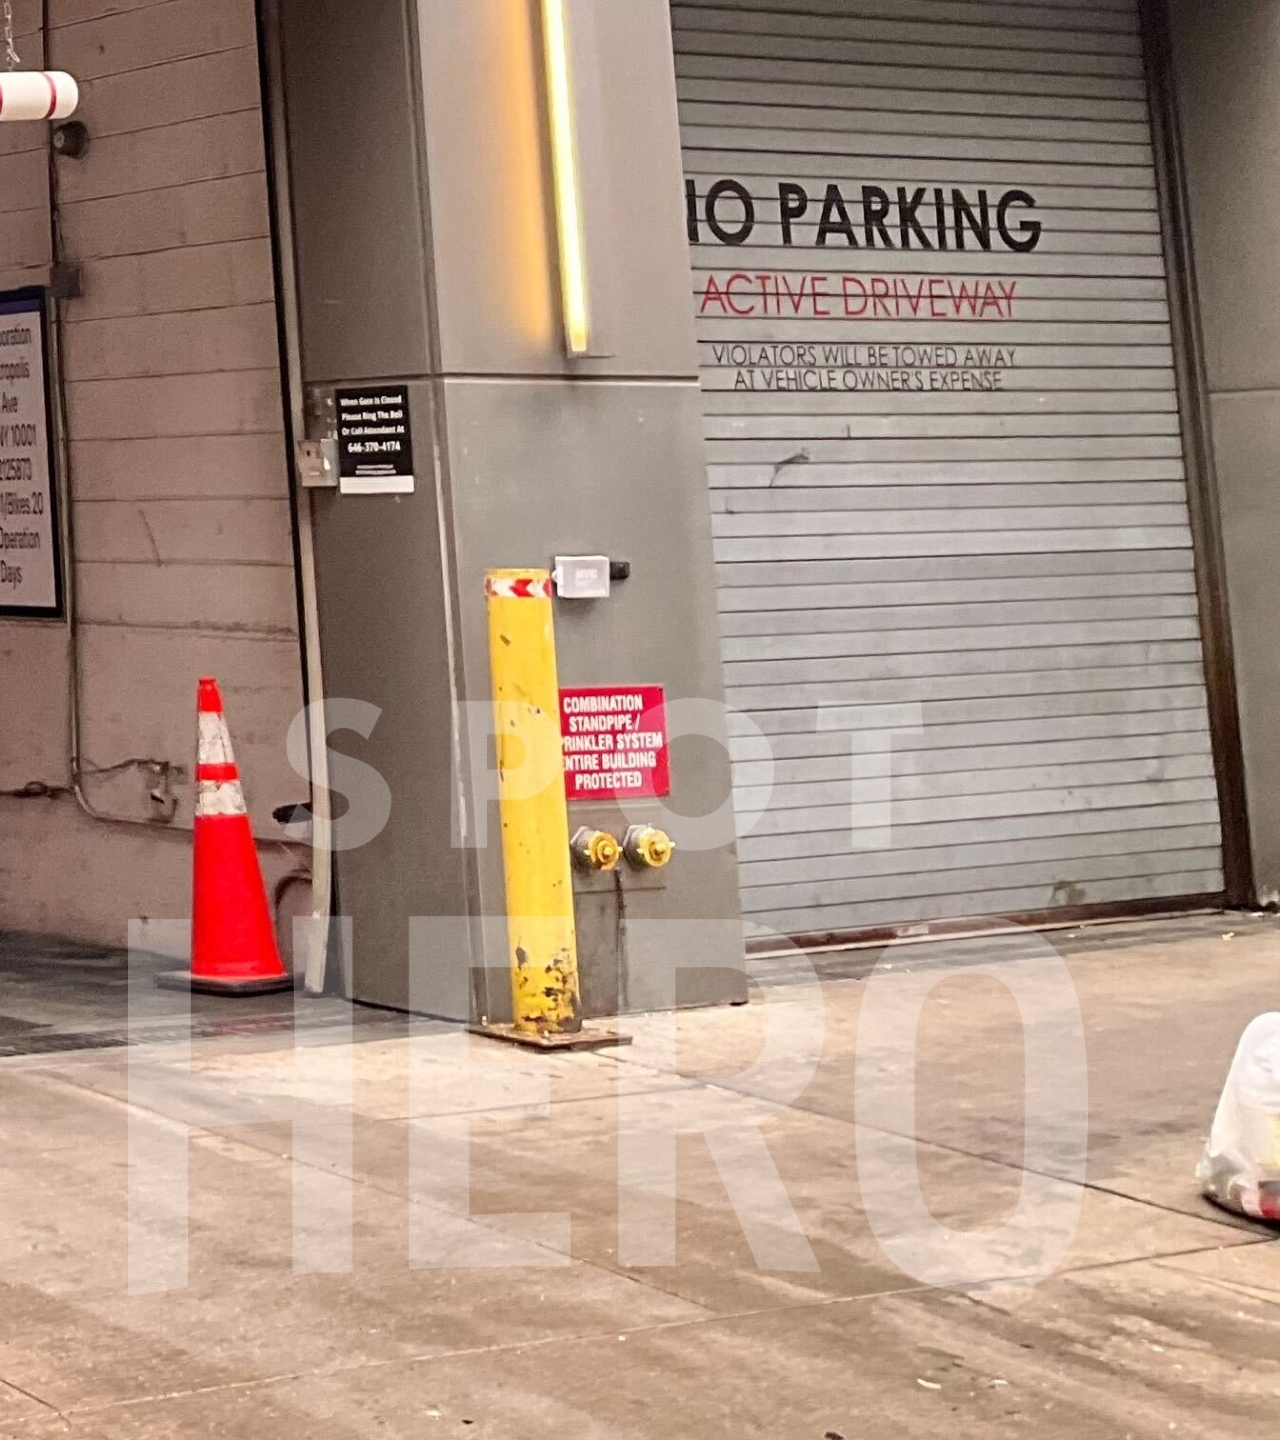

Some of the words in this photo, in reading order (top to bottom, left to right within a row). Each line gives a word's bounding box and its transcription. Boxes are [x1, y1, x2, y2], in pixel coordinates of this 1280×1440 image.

[778, 182, 1042, 252] PARKING
[700, 274, 831, 316] ACTIVE
[842, 277, 1017, 317] DRIVEWAY
[713, 344, 817, 366] VIOLATORS
[822, 345, 864, 366] WILL
[867, 346, 888, 366] BE
[892, 347, 957, 367] TOWED
[965, 348, 1016, 368] AWAY
[734, 369, 757, 390] AT
[761, 369, 838, 390] VEHICLE
[844, 370, 924, 391] OWNER'S
[929, 370, 1004, 391] EXPENSE
[2, 392, 18, 413] Ave
[11, 424, 37, 447] 10001
[32, 491, 43, 515] 20
[1, 560, 23, 589] Days
[563, 695, 643, 713] COMBINATION
[569, 714, 632, 732] STANDPIPE
[635, 713, 640, 730] /
[561, 734, 613, 752] RINKLER
[617, 732, 663, 749] SYSTEM
[563, 754, 599, 771] NTIRE
[602, 752, 656, 769] BUILDING
[575, 771, 642, 790] PROTECTED
